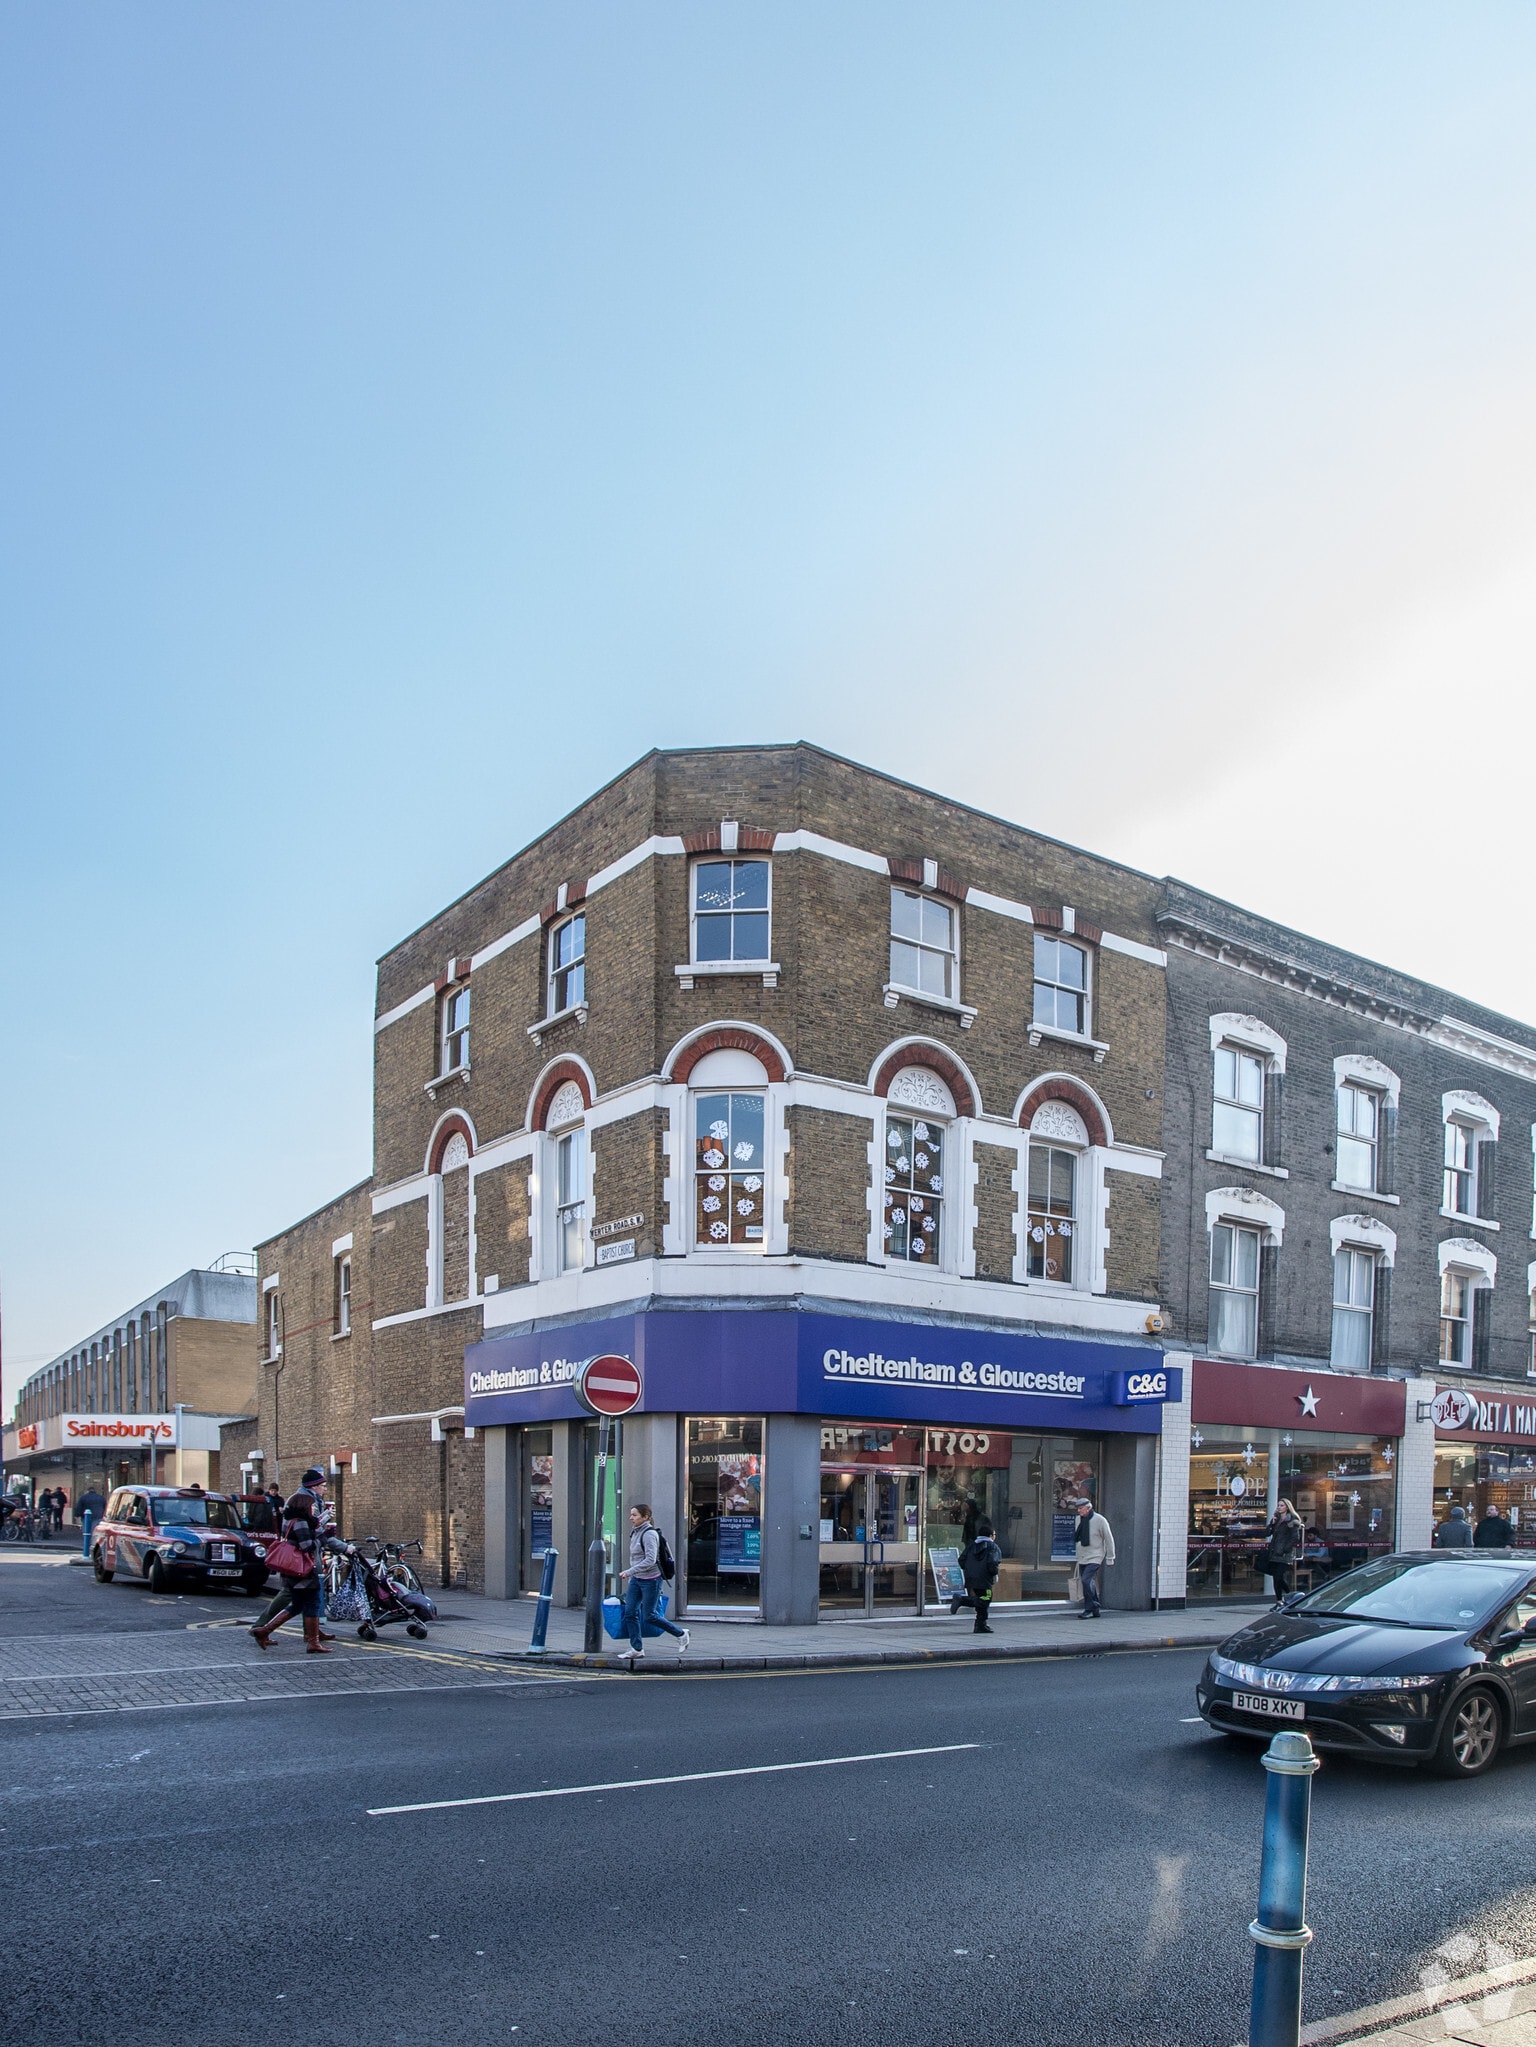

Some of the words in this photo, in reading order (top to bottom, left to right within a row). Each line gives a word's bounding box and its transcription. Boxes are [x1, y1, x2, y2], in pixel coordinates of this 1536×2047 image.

[601, 1245, 617, 1261] BAPTIST
[617, 1242, 634, 1257] CHURCH
[470, 1366, 538, 1392] Cheltenham
[540, 1361, 552, 1383] &
[823, 1349, 956, 1383] Cheltenham
[958, 1361, 978, 1385] &
[979, 1363, 1086, 1393] Gloucester
[1127, 1372, 1167, 1394] C&G
[1437, 1400, 1465, 1420] PRET
[1503, 1403, 1512, 1433] A
[67, 1420, 172, 1440] Sainsbury's
[1215, 1476, 1266, 1498] HOPE
[1237, 1694, 1269, 1711] BT08
[1272, 1699, 1298, 1715] XKY
